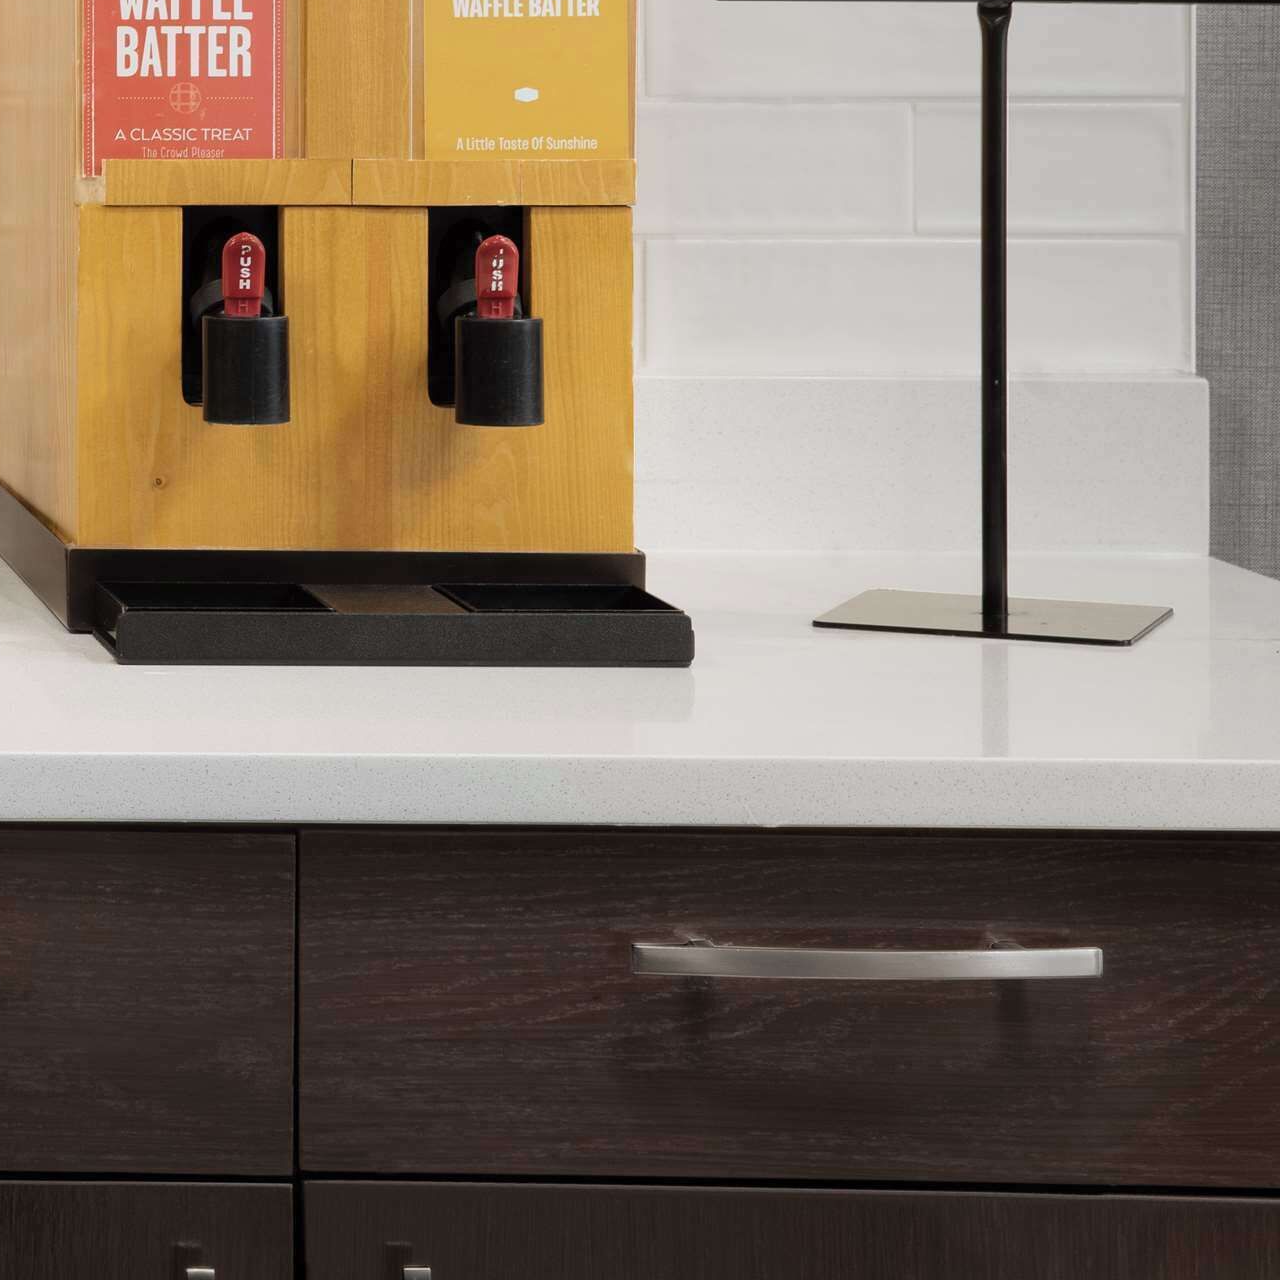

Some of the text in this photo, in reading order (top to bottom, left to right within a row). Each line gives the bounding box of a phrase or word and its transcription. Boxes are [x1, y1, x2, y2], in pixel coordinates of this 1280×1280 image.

[116, 25, 252, 77] BATTER
[114, 127, 252, 141] A CLASSIC TREAT
[456, 138, 464, 150] A
[466, 137, 495, 150] Little
[531, 136, 543, 150] Of
[546, 136, 597, 150] Sunshine
[142, 146, 225, 158] The Crowd Pleaser
[238, 245, 252, 290] PUSH
